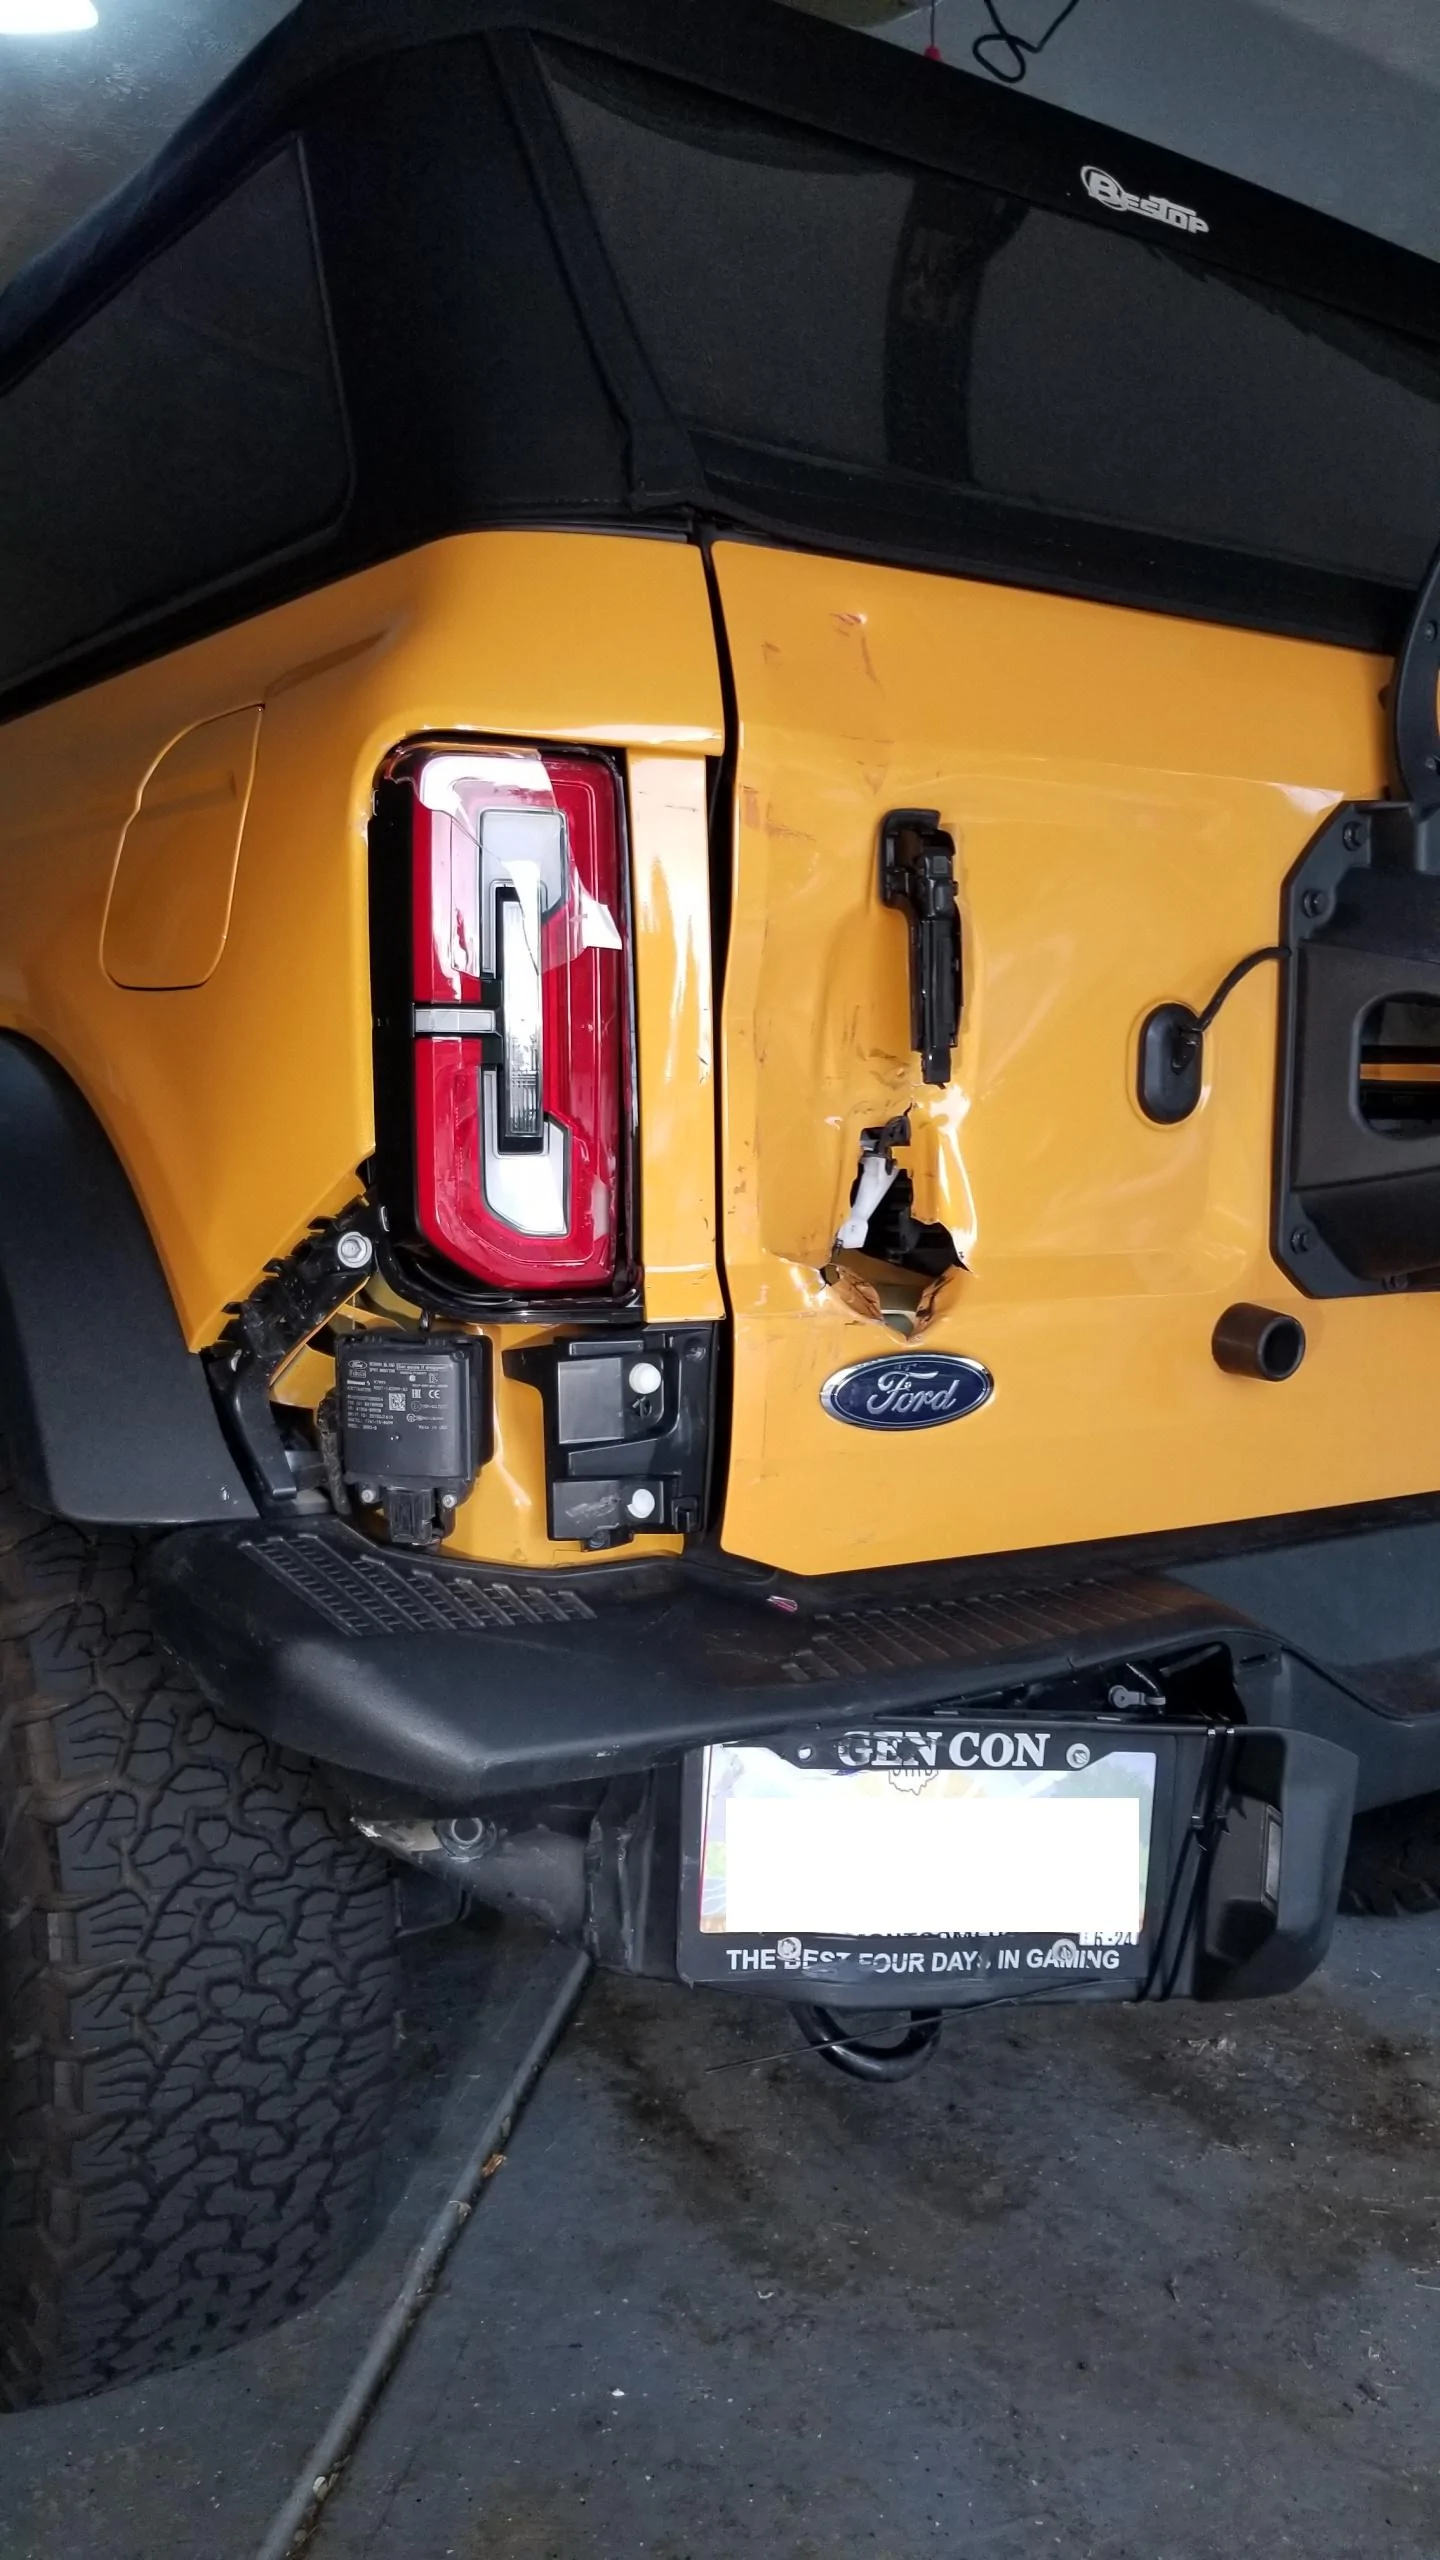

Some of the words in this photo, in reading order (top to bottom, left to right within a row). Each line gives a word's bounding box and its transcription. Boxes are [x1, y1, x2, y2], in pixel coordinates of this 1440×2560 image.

[866, 1370, 960, 1415] Ford
[838, 1731, 943, 1767] GEN
[949, 1731, 1051, 1767] CON
[727, 1949, 776, 1970] THE
[859, 1952, 925, 1973] FOUR
[998, 1949, 1020, 1969] IN
[1026, 1948, 1120, 1970] GAMING
